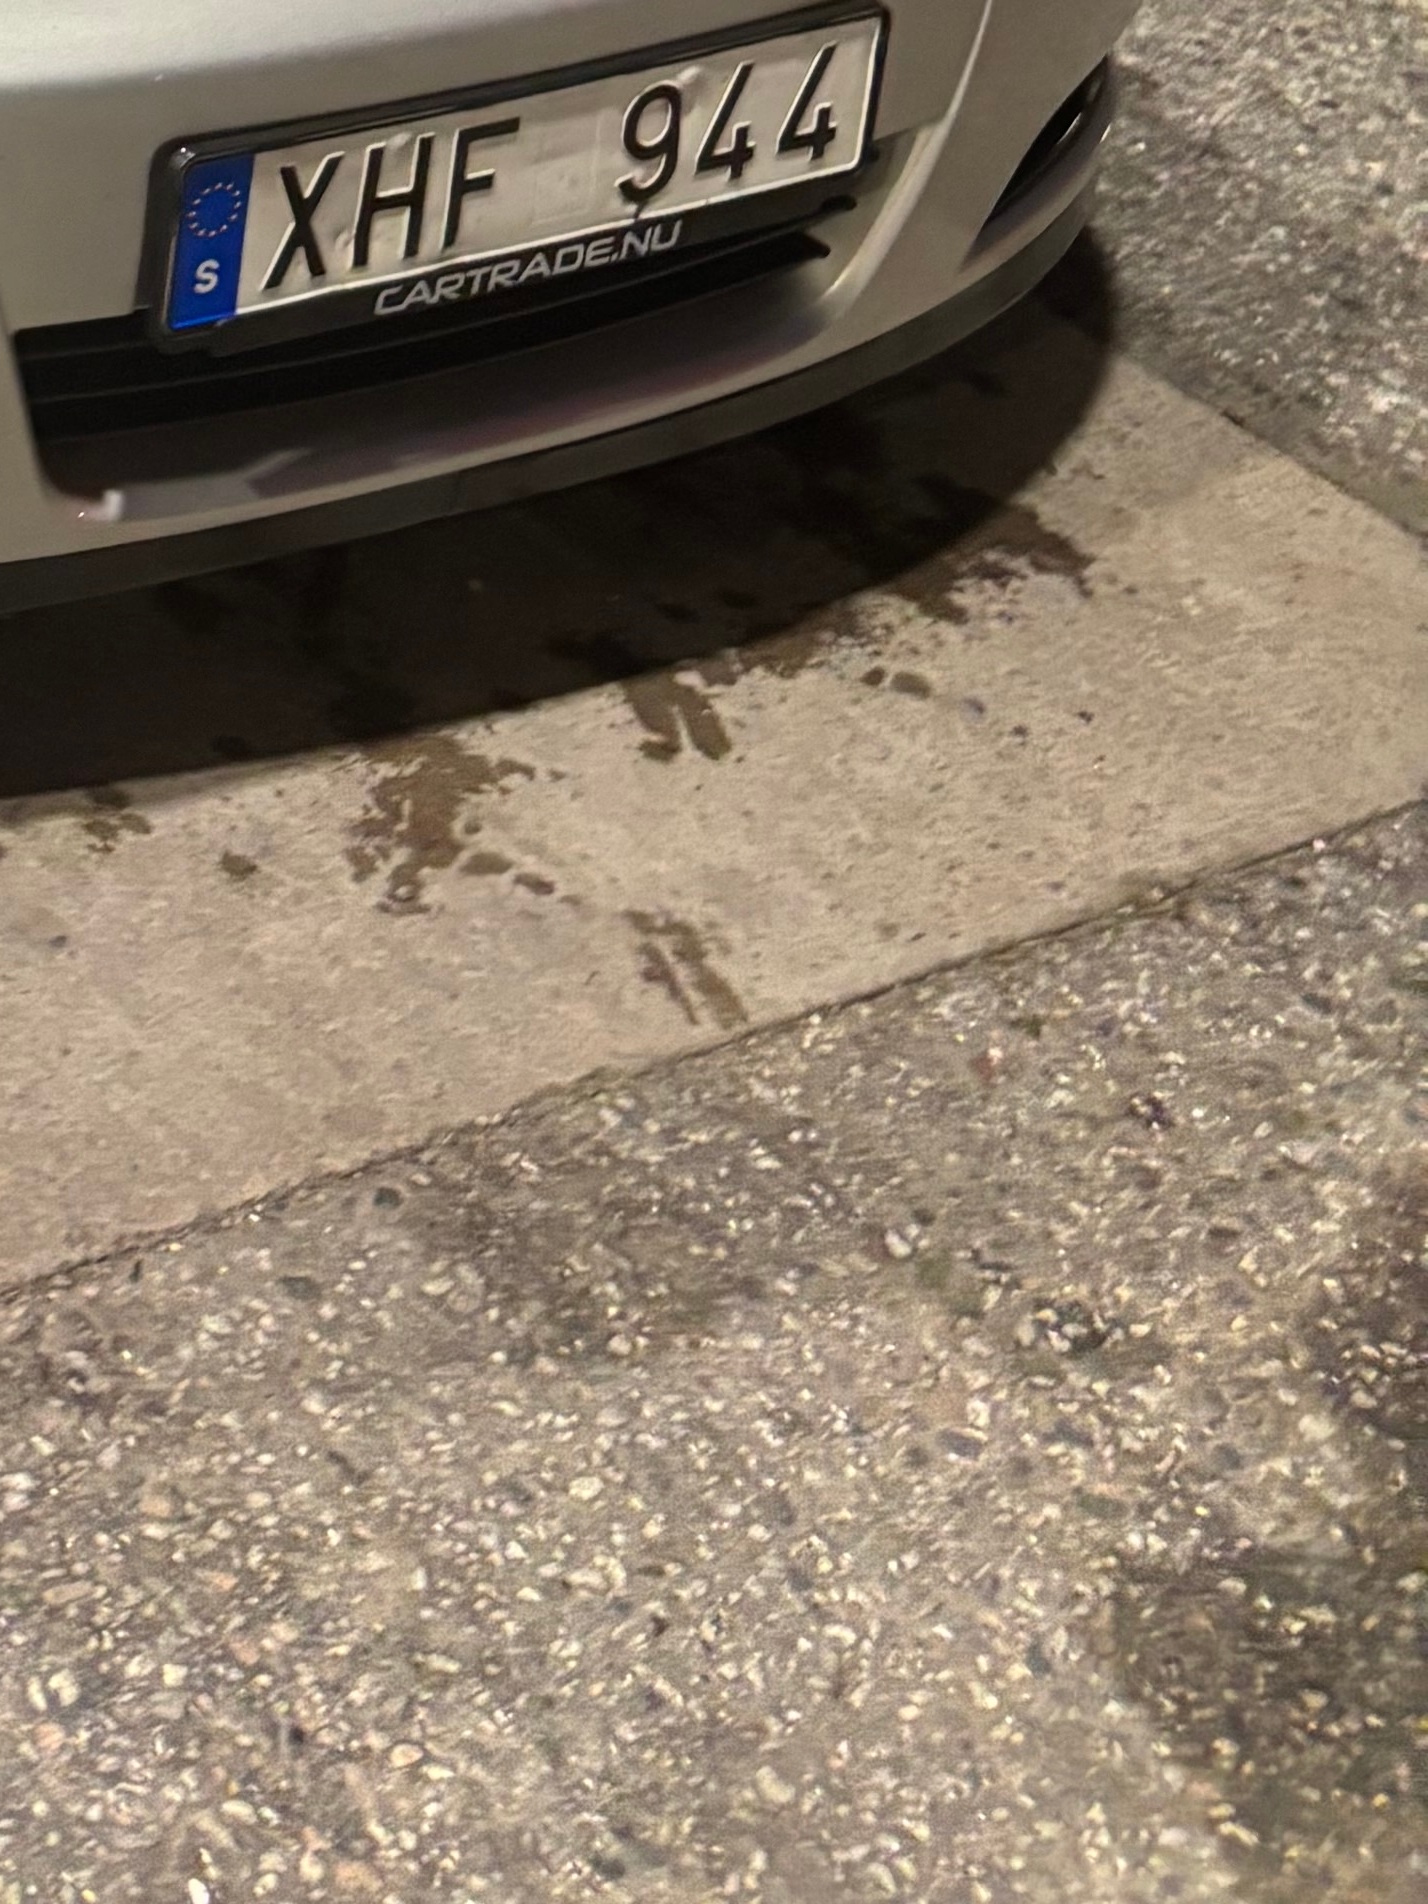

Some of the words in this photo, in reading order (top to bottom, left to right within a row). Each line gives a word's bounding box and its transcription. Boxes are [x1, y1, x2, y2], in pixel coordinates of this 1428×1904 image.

[257, 116, 521, 293] XHF
[613, 40, 839, 204] 944
[193, 258, 221, 295] S
[373, 219, 684, 316] CARTRADE.NU
